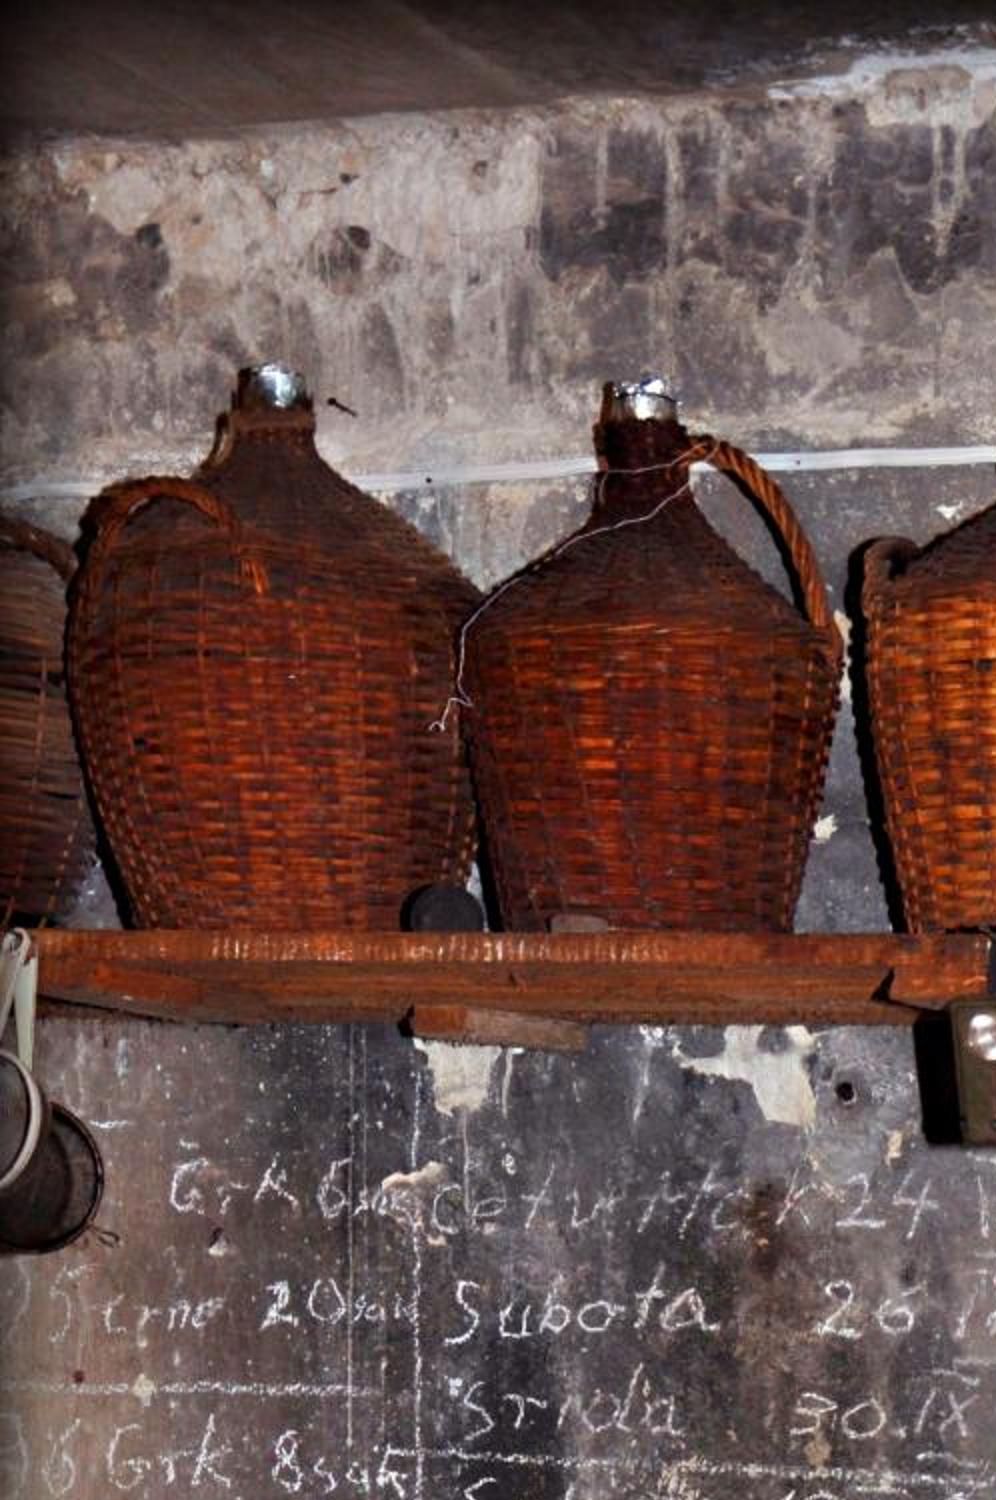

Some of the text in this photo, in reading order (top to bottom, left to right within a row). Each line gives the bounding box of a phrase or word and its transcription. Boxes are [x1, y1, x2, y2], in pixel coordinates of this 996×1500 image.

[834, 1168, 941, 1240] 24
[443, 1262, 720, 1346] Subota
[816, 1279, 928, 1340] 26
